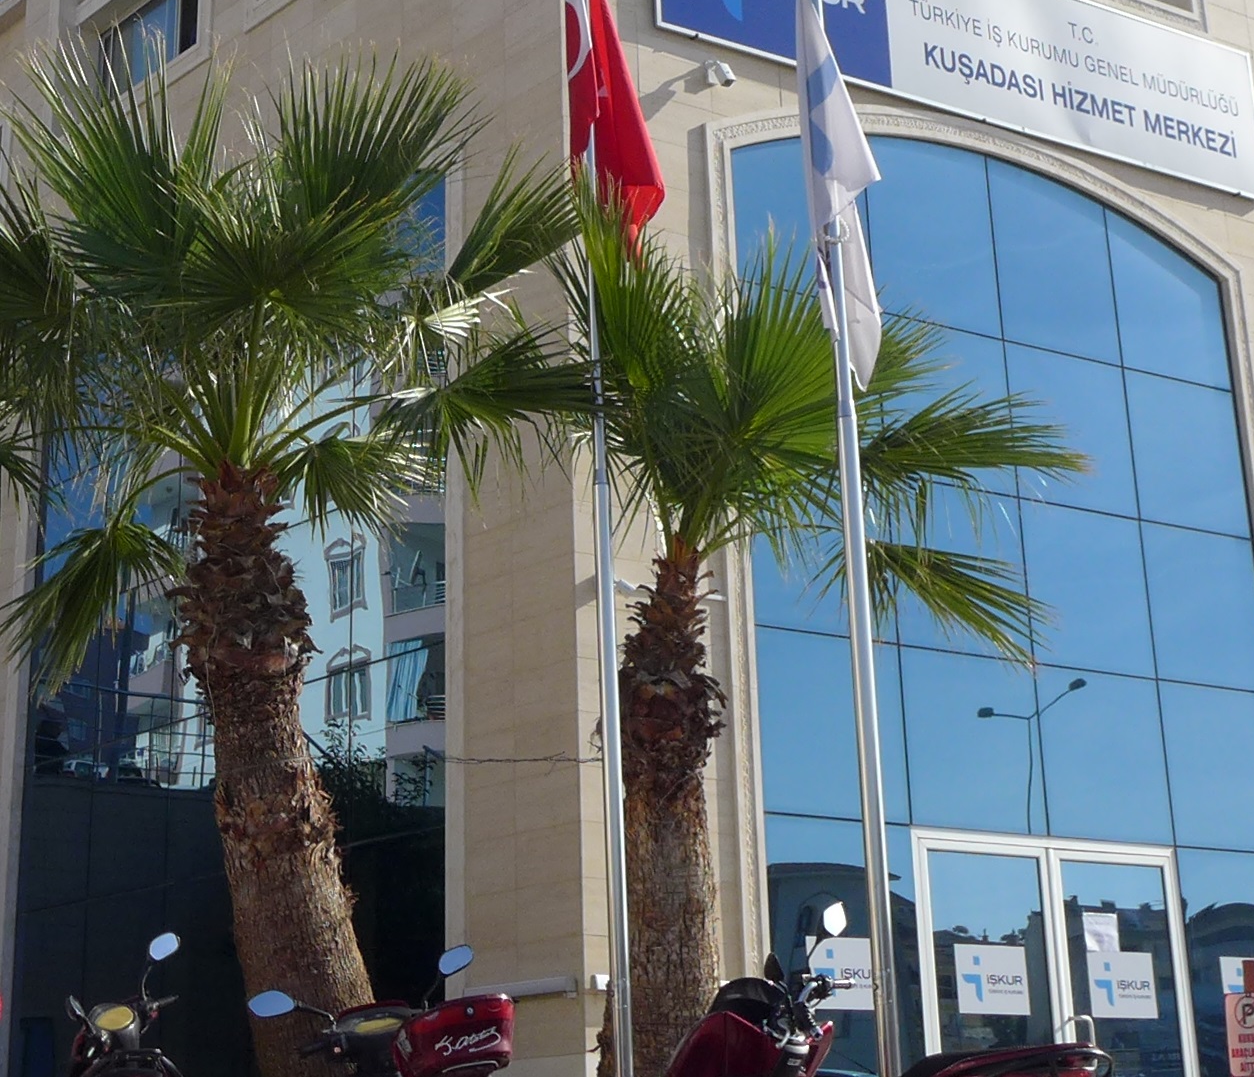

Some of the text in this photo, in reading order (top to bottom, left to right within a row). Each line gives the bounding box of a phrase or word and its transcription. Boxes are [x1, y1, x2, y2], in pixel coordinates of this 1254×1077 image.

[923, 42, 1237, 158] KUŞADASI HİZMET MERKEZİ
[987, 19, 1003, 47] İŞ
[1007, 30, 1079, 68] KURUMU
[1084, 55, 1139, 86] GENEL
[1142, 73, 1239, 117] MÜDÜRLÜĞÜ
